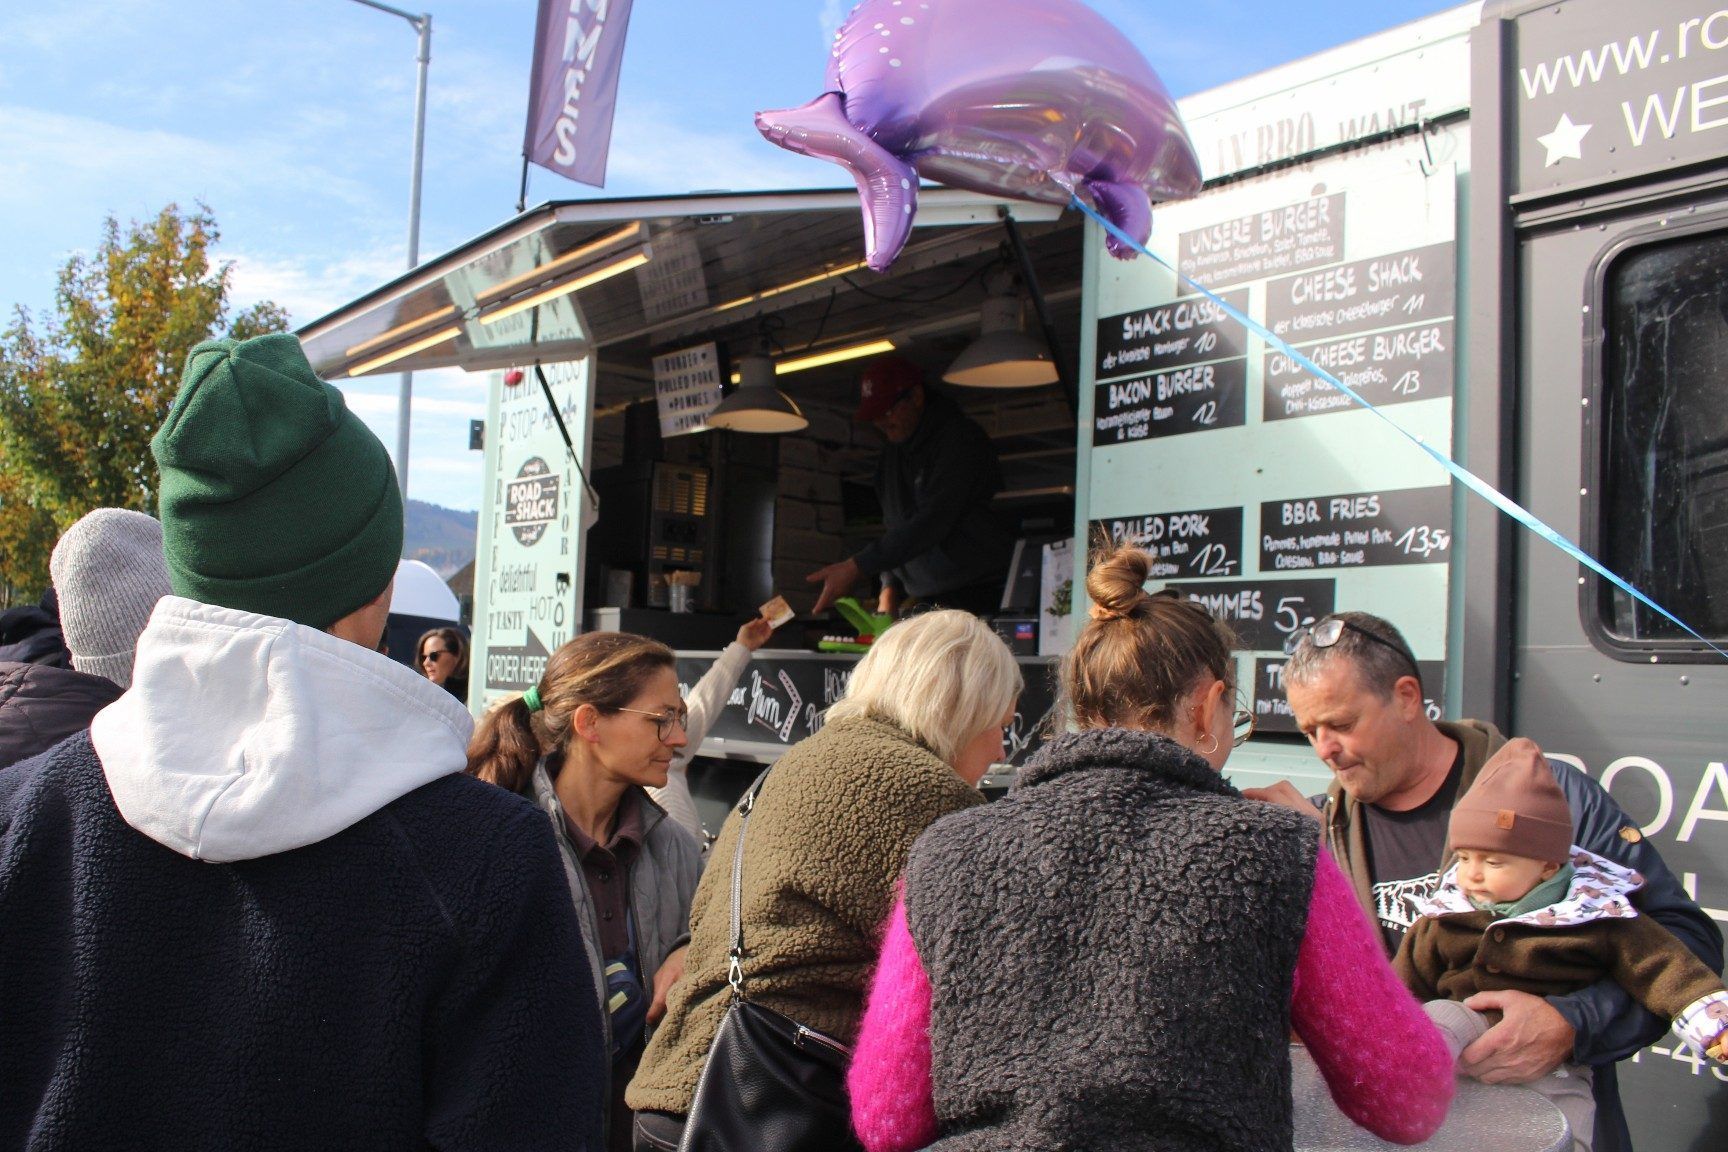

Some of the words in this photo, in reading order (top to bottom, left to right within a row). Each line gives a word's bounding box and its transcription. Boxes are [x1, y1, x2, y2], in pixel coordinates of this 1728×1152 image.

[1621, 74, 1728, 147] WE
[1188, 217, 1252, 254] UNSERE
[1261, 197, 1330, 241] BURGER
[1291, 266, 1357, 306] CHEESE
[1367, 255, 1423, 292] SHACK
[1402, 293, 1425, 315] 11
[1122, 308, 1171, 341] SHACK
[1194, 331, 1217, 354] 10
[1372, 326, 1446, 361] BURGER
[1108, 376, 1151, 409] BACON
[1157, 365, 1216, 401] BURGER
[1392, 369, 1421, 396] 13
[1191, 400, 1218, 426] 12
[510, 482, 542, 504] ROAD
[515, 498, 555, 522] SHACK
[1281, 500, 1321, 526] BBQ
[1329, 495, 1381, 521] FRIES
[1112, 516, 1165, 544] PULLED
[1168, 513, 1210, 538] PORK
[487, 654, 519, 684] ORDER
